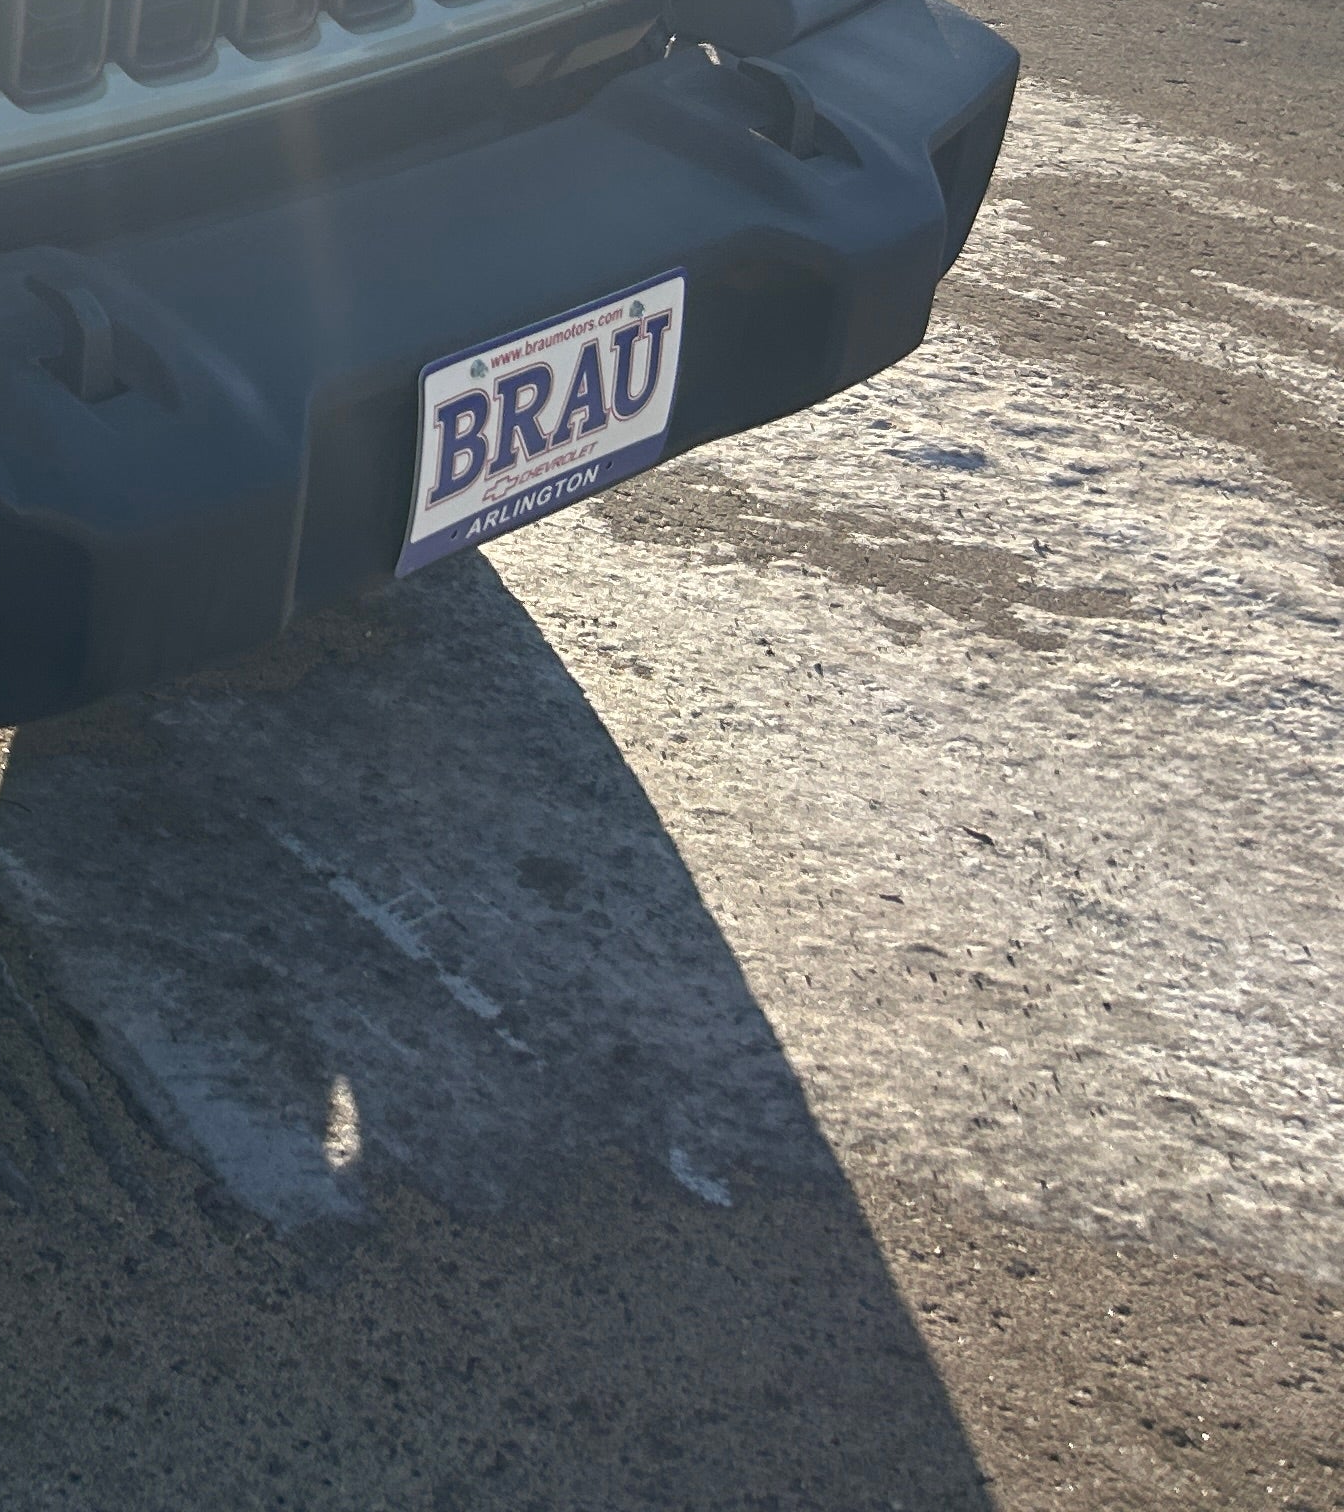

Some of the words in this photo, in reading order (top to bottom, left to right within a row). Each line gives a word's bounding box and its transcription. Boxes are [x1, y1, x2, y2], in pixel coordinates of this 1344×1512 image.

[490, 308, 623, 368] www.braumotors.com
[426, 309, 672, 510] BRAU
[518, 441, 598, 484] CHEVROLET
[465, 464, 600, 538] ARLINGTON
